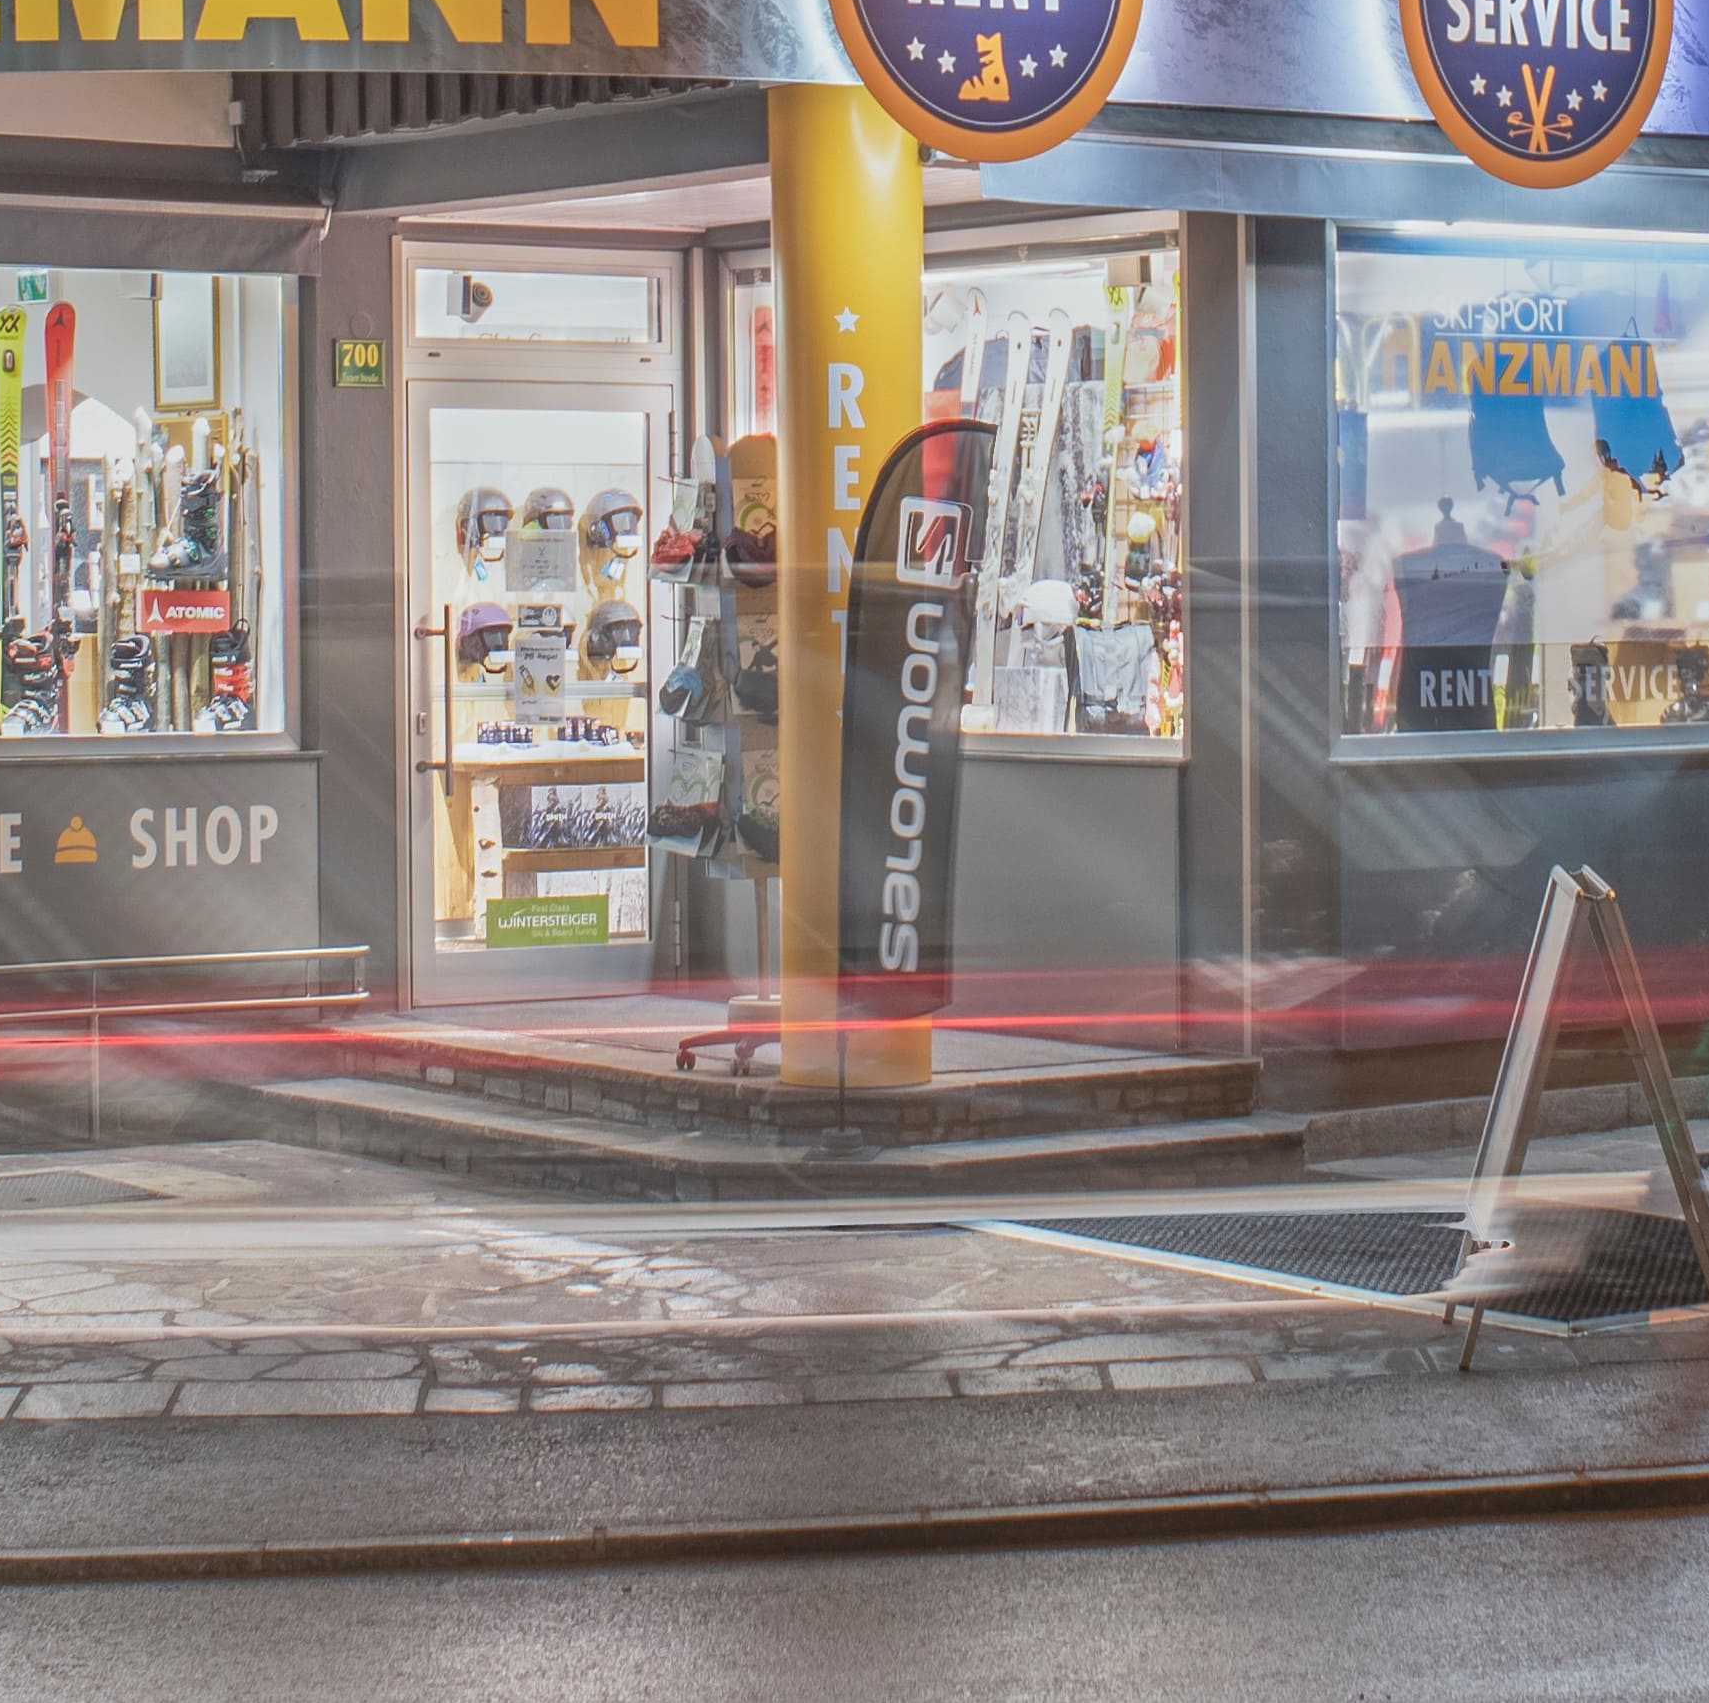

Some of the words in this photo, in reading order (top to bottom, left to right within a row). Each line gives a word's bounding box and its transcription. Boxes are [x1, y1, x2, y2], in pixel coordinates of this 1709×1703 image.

[1432, 298, 1568, 332] SKI-SPORT
[342, 344, 379, 368] 700
[165, 605, 225, 620] ATOMIC
[1419, 668, 1493, 708] RENT
[1568, 663, 1683, 703] SERVICE
[128, 804, 280, 869] SHOP
